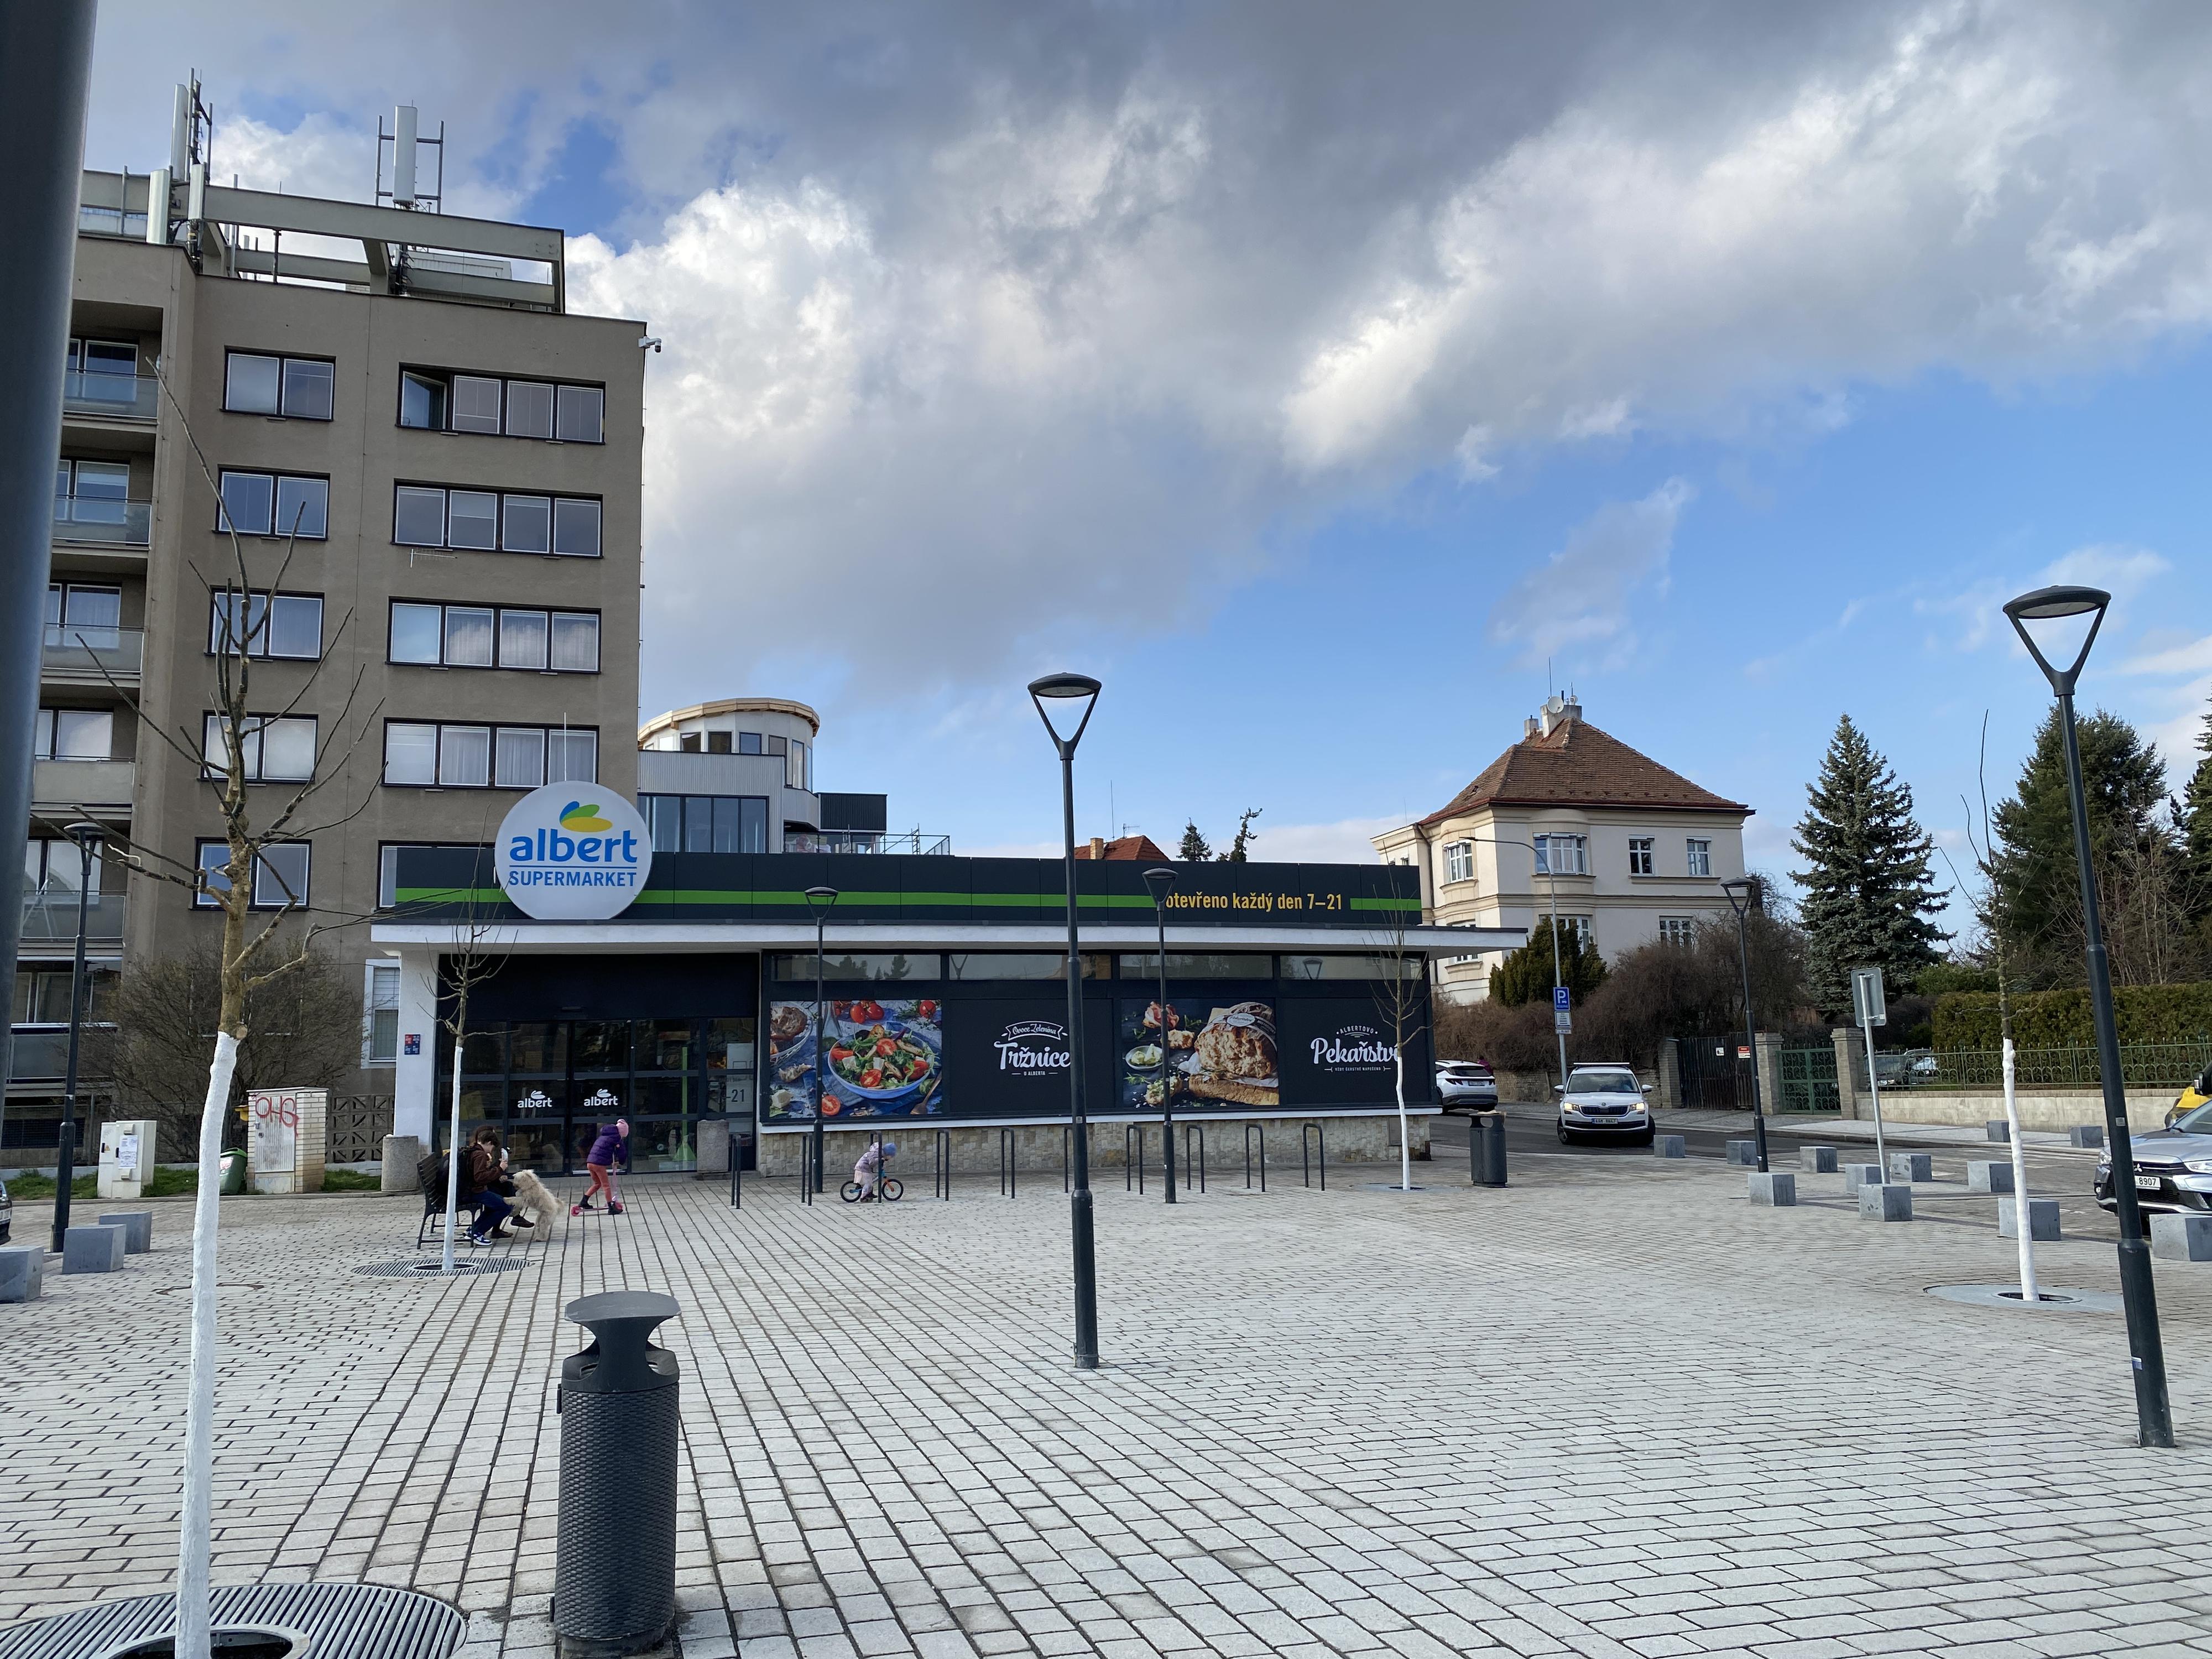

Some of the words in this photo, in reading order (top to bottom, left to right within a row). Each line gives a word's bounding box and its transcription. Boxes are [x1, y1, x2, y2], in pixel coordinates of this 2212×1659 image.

[509, 828, 637, 863] albert
[509, 870, 637, 886] SUPERMARKET
[1166, 891, 1228, 909] otevřeno
[1233, 892, 1273, 912] každý
[1277, 893, 1302, 909] den
[1557, 990, 1566, 1004] P
[1012, 1026, 1031, 1035] Ovoce
[1030, 1023, 1056, 1035] Zelenina
[1339, 1025, 1374, 1034] ALBERTOVO
[993, 1041, 1071, 1070] Tržnice
[517, 1097, 552, 1108] albert
[583, 1095, 618, 1107] albert
[2138, 1177, 2157, 1186] 8907
